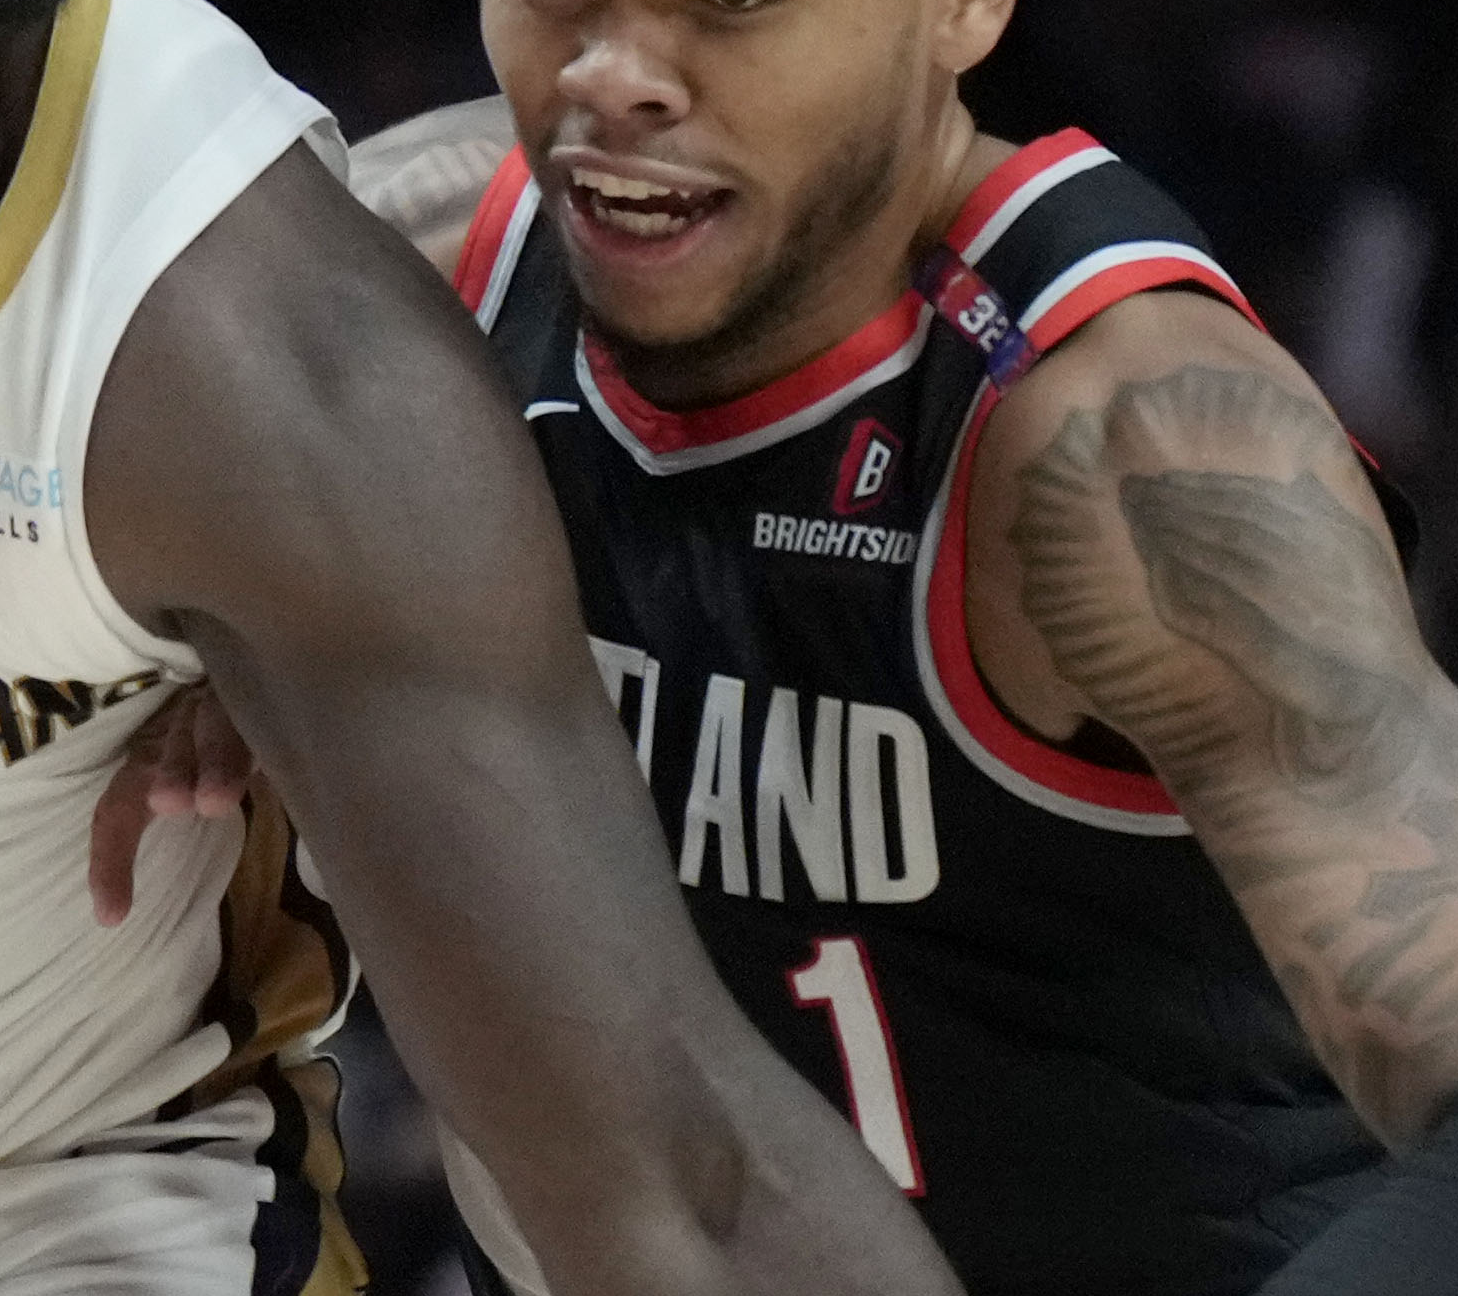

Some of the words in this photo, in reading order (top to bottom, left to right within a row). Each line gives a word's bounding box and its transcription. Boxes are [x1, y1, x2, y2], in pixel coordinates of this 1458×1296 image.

[853, 438, 892, 498] B
[753, 511, 917, 565] BRIGHTSID
[786, 933, 927, 1198] 1
